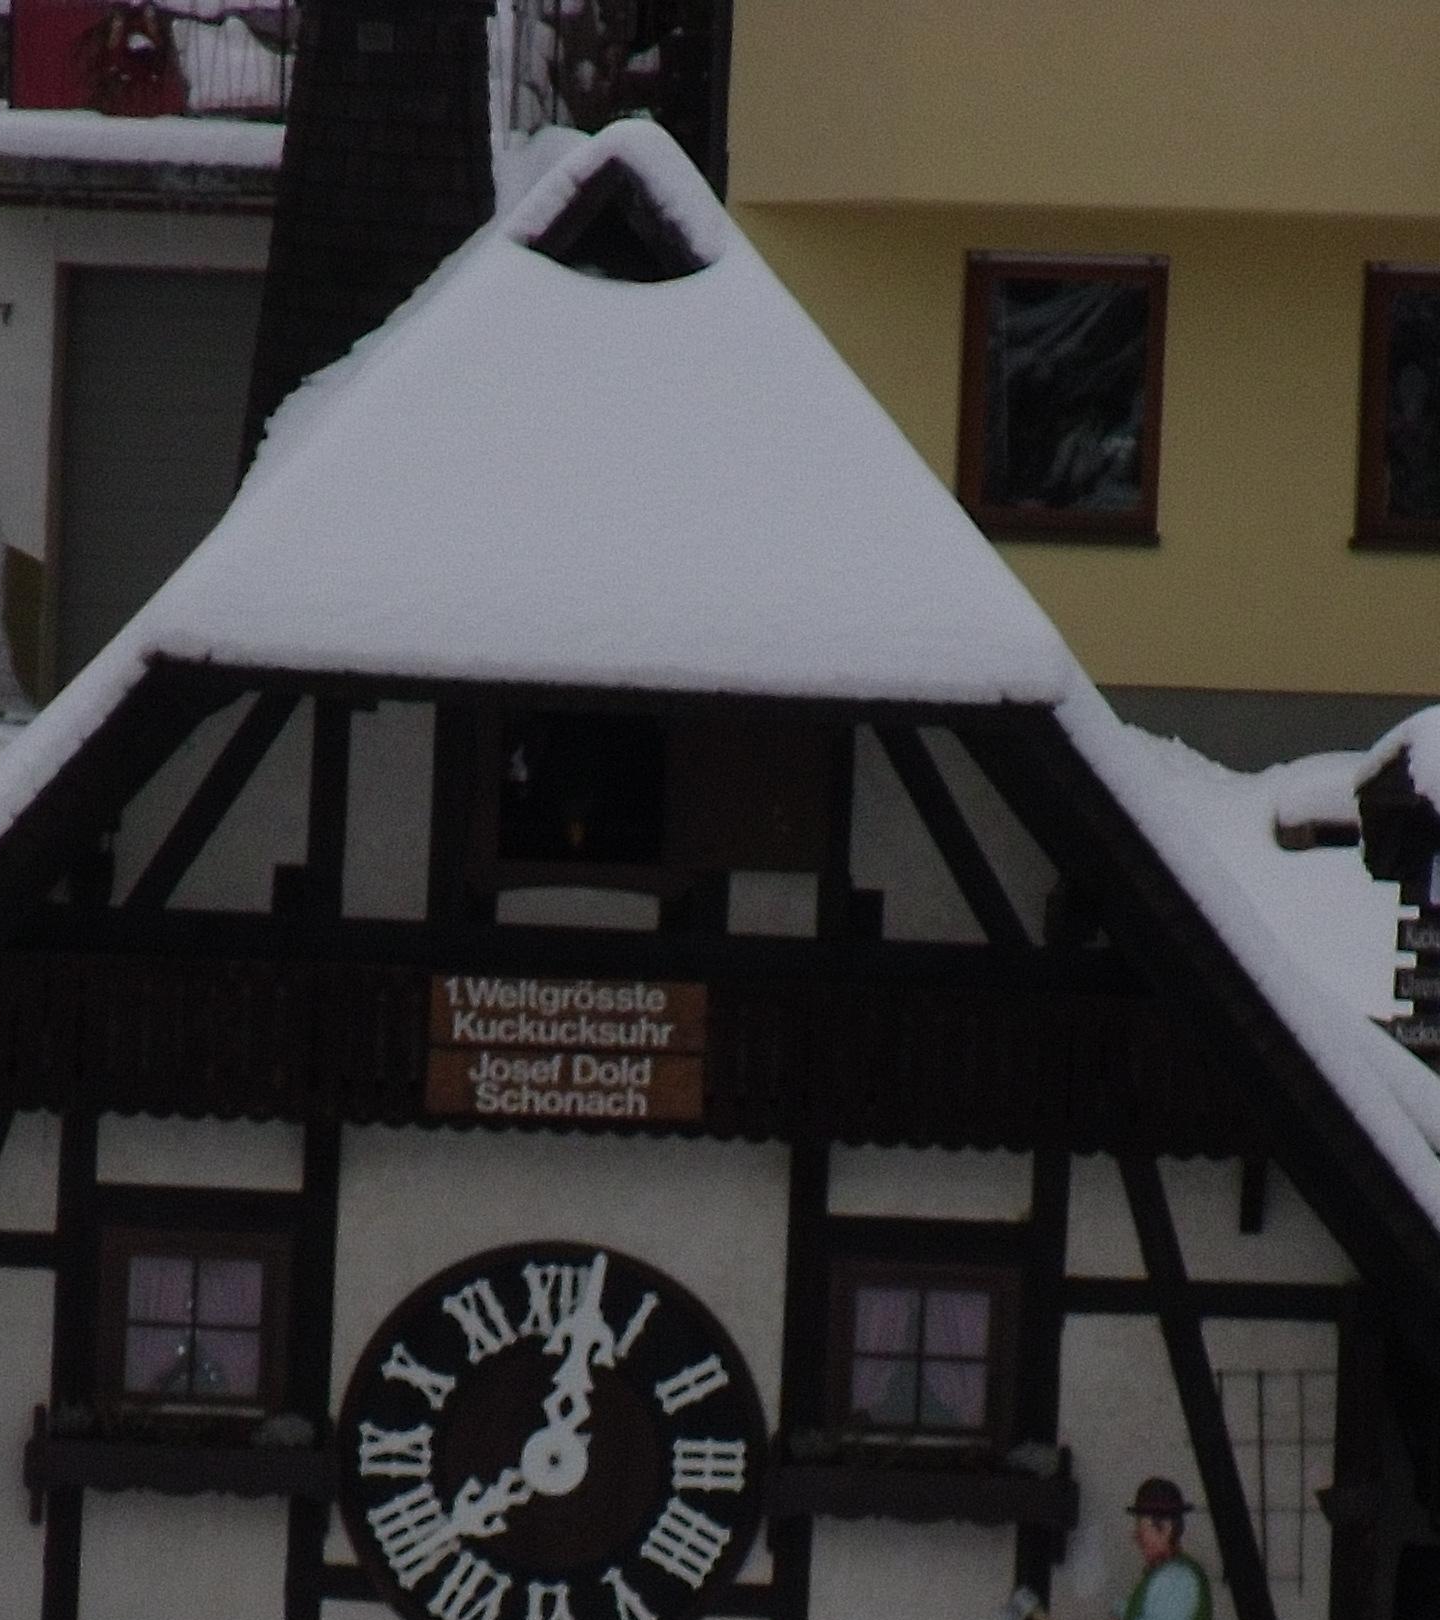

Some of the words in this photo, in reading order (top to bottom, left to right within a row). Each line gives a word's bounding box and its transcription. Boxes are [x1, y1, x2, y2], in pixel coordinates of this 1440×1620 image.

[452, 1010, 674, 1047] Kuckucksuhr
[468, 1052, 563, 1084] Josef
[572, 1053, 652, 1087] Dold
[475, 1081, 648, 1117] Schonach
[442, 1278, 517, 1365] XI
[381, 1342, 456, 1411] X
[655, 1353, 729, 1415] II
[359, 1421, 434, 1477] IX
[673, 1437, 746, 1492] III
[641, 1497, 732, 1590] IIII
